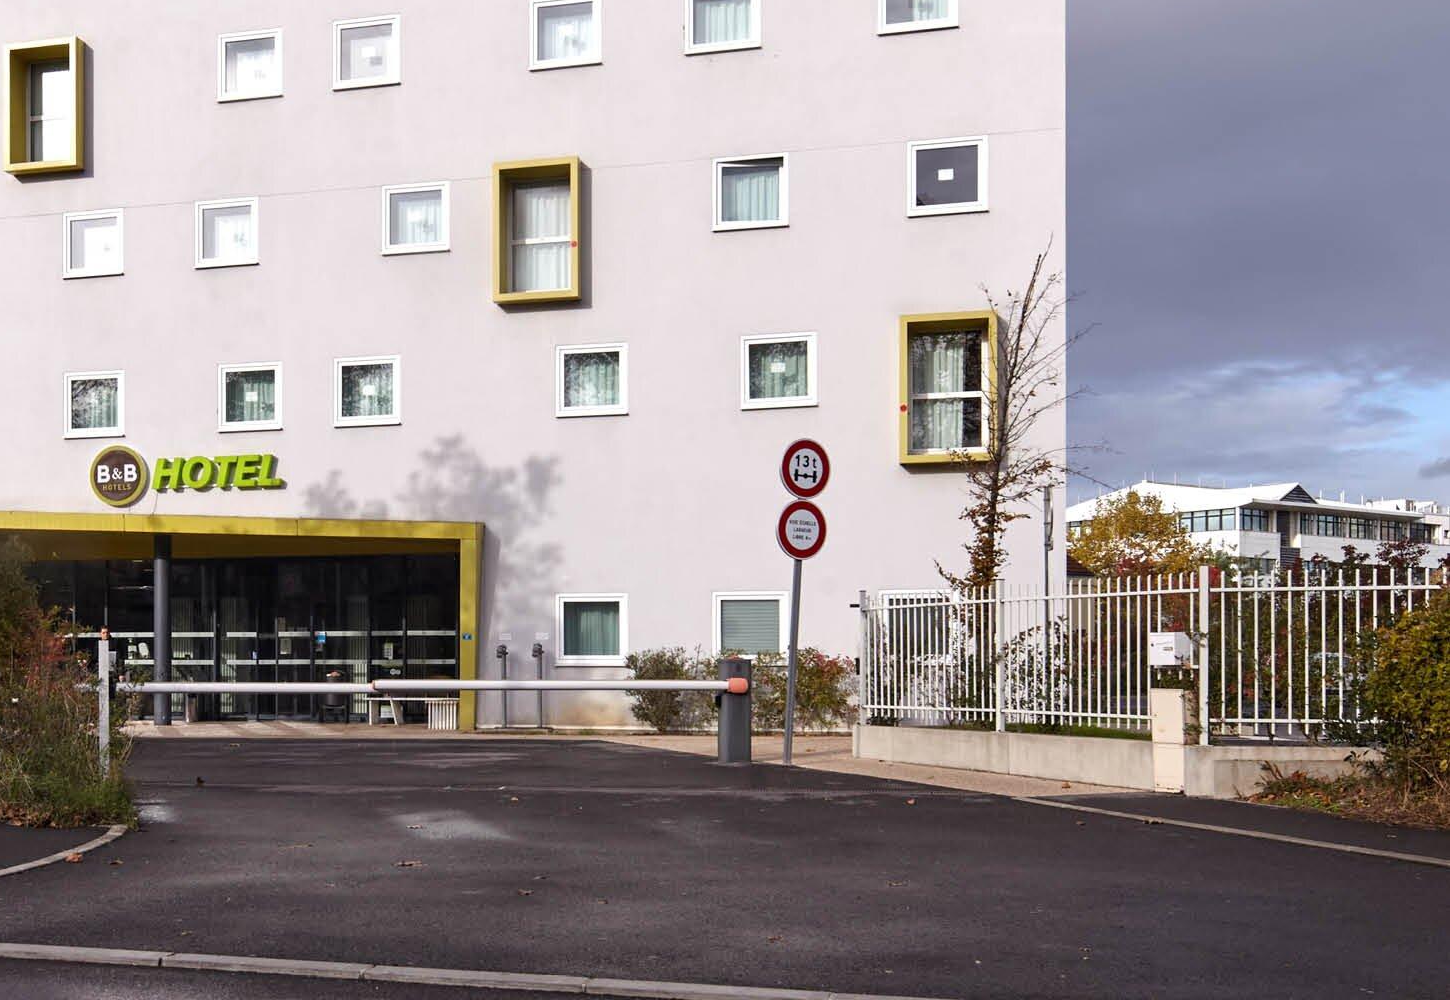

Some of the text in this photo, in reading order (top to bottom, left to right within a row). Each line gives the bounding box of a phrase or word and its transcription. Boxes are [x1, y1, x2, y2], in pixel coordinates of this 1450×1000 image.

[97, 463, 138, 484] B&B
[151, 454, 284, 491] HOTEL
[102, 483, 132, 492] HOTELS
